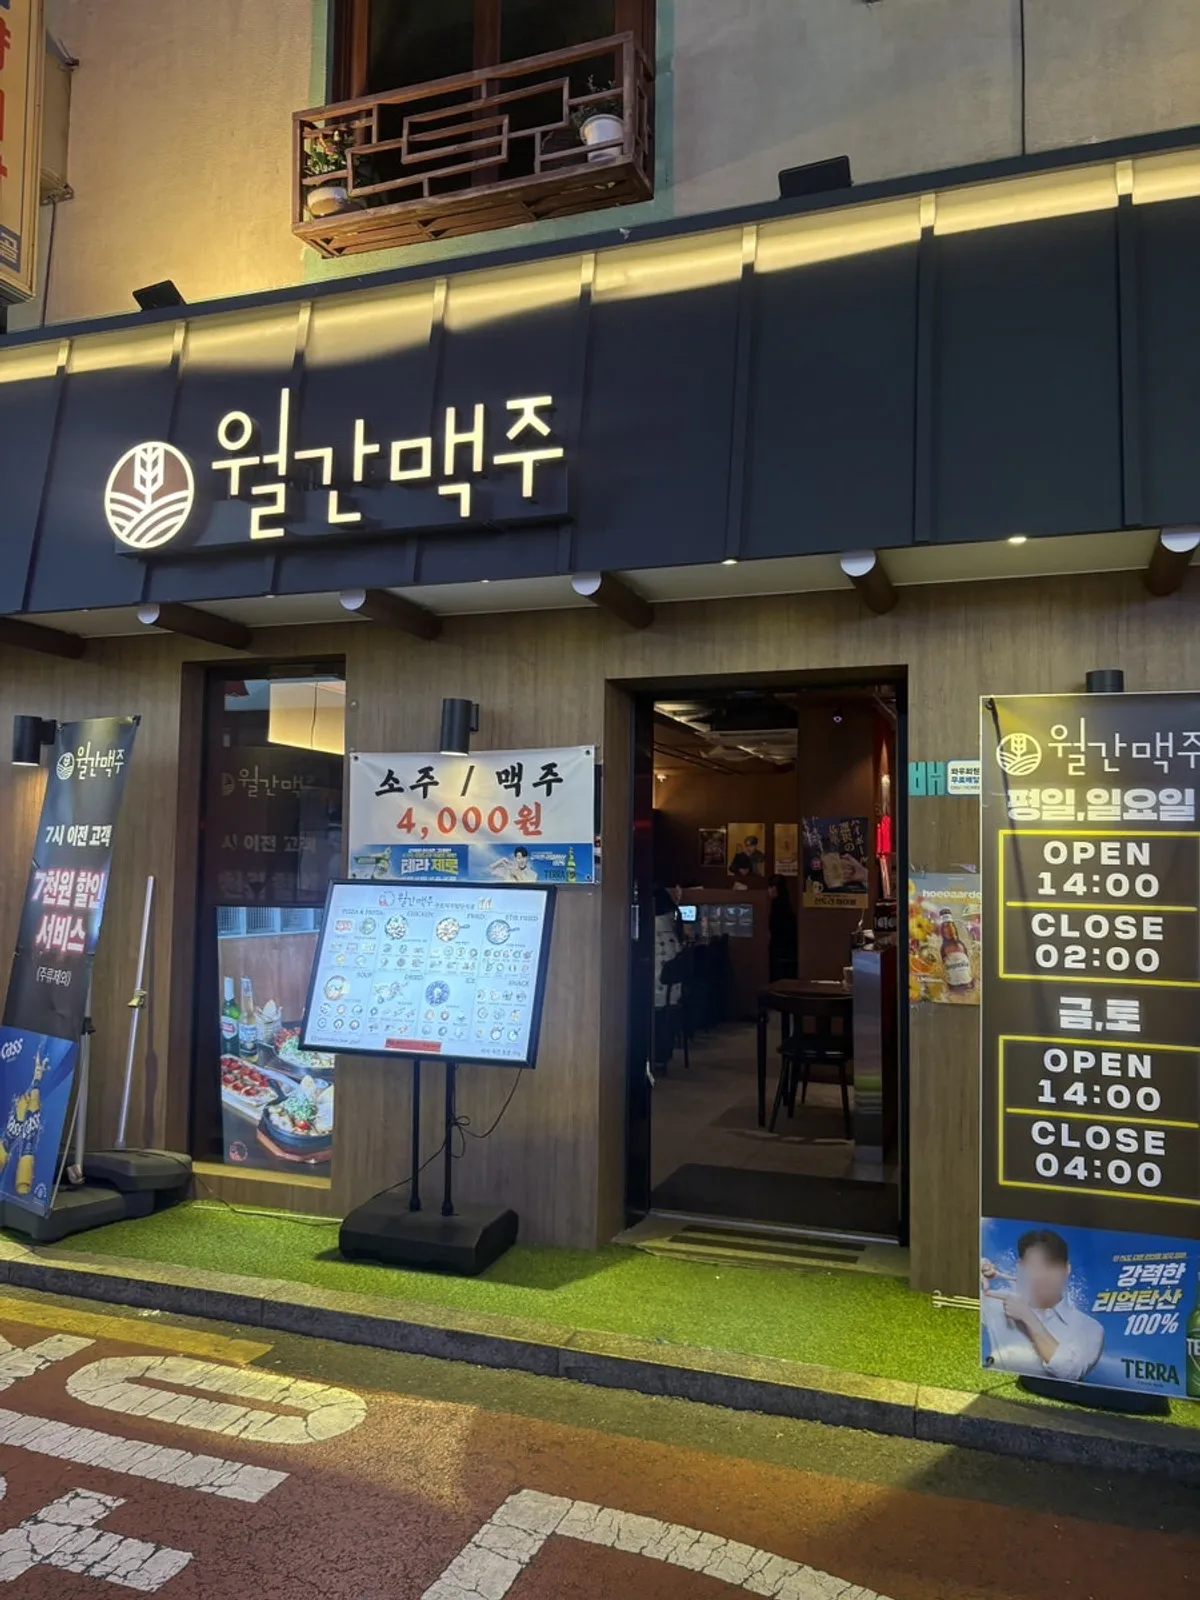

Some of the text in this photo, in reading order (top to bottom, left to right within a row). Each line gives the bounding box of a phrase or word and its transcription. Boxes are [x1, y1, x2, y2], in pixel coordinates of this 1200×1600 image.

[212, 387, 564, 540] 월간맥주
[76, 741, 125, 780] 월간맥주
[1048, 717, 1200, 776] 월간맥주
[375, 762, 564, 800] 소주 / 맥주
[396, 801, 543, 840] 4,000원
[1007, 788, 1195, 822] 평일,일요일
[45, 824, 112, 847] 7시 이전 고객
[1043, 841, 1151, 866] OPEN
[31, 869, 105, 909] 7천원 할인
[1037, 872, 1160, 898] 14:00
[36, 914, 86, 952] 서비스
[1031, 913, 1164, 940] CLOSE
[1035, 944, 1160, 972] 02:00
[1059, 996, 1141, 1032] 금,토
[1043, 1048, 1152, 1080] OPEN
[1037, 1079, 1162, 1112] 14:00
[1031, 1120, 1166, 1156] CLOSE
[1035, 1152, 1162, 1188] 04:00
[1117, 1263, 1186, 1287] 강력한
[1092, 1289, 1182, 1312] 리얼탄산
[1124, 1312, 1179, 1336] 100%
[1121, 1358, 1180, 1386] TERRA
